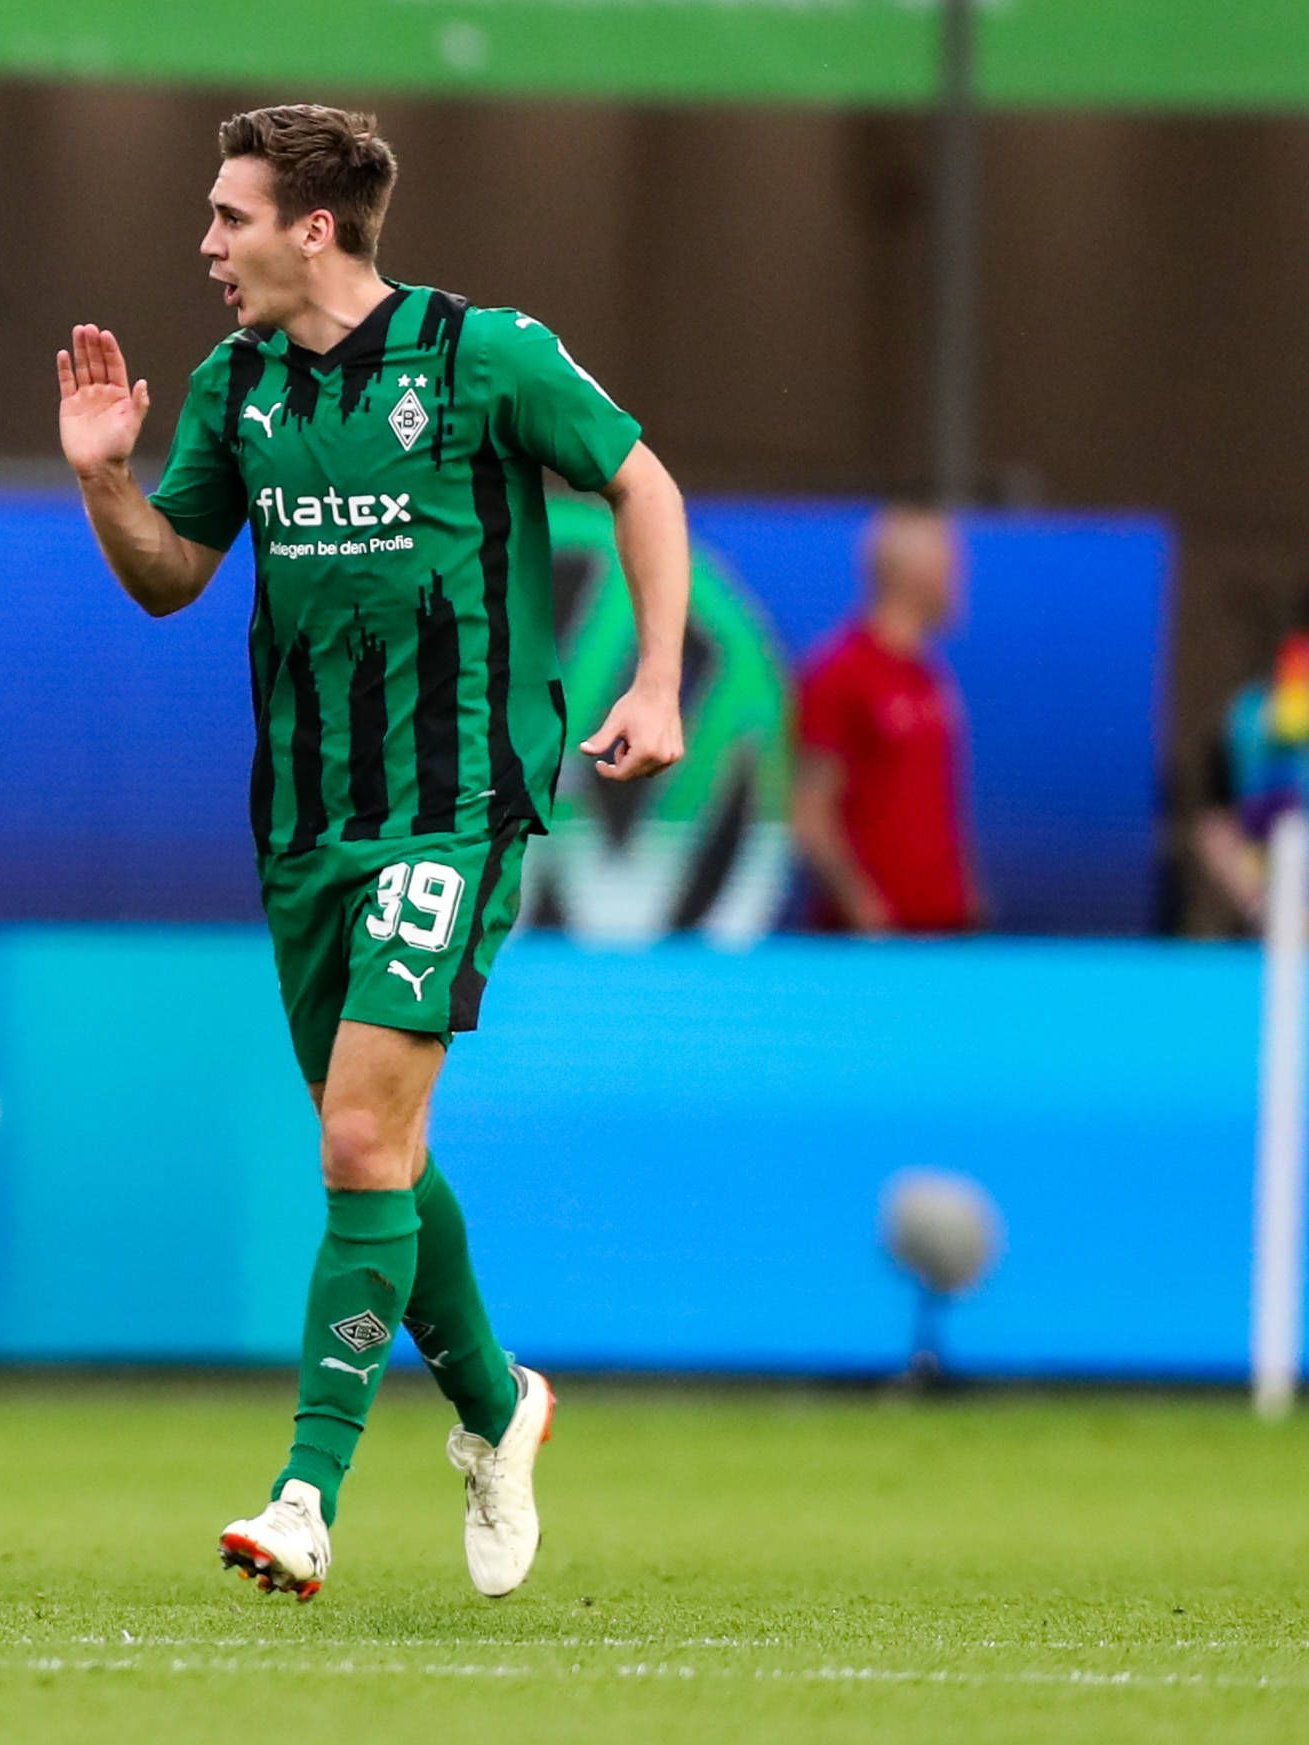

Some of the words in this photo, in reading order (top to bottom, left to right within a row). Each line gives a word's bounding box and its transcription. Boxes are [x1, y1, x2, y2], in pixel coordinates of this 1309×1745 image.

[317, 541, 337, 555] bei
[340, 541, 367, 555] den
[370, 535, 414, 553] Profis
[366, 861, 465, 952] 39
